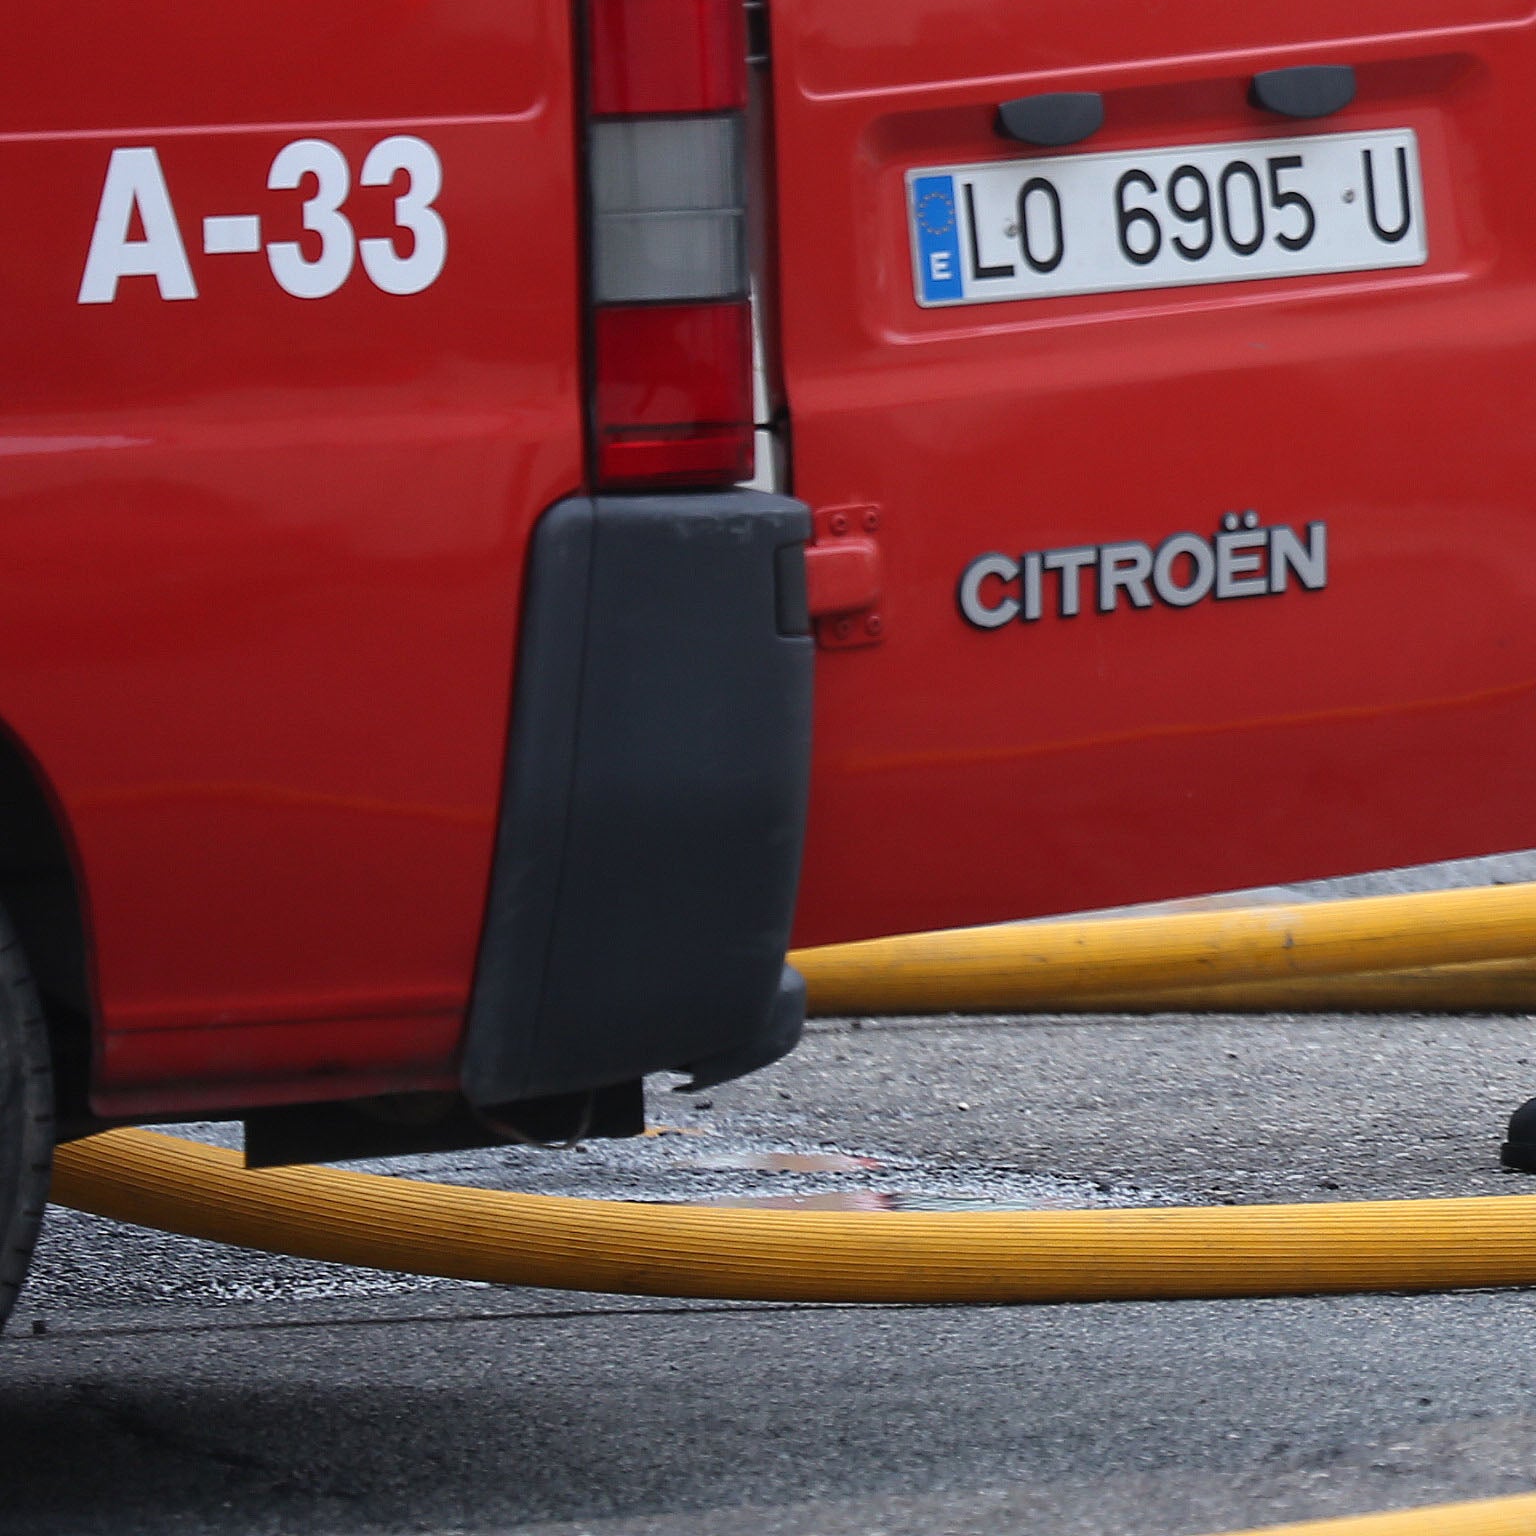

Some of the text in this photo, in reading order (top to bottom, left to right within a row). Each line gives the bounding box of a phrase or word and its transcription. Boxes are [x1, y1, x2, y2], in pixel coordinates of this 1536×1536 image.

[77, 134, 448, 305] A-33
[930, 250, 952, 282] E
[1115, 154, 1317, 266] 6905
[1362, 146, 1412, 245] U
[958, 508, 1329, 631] CITROËN
